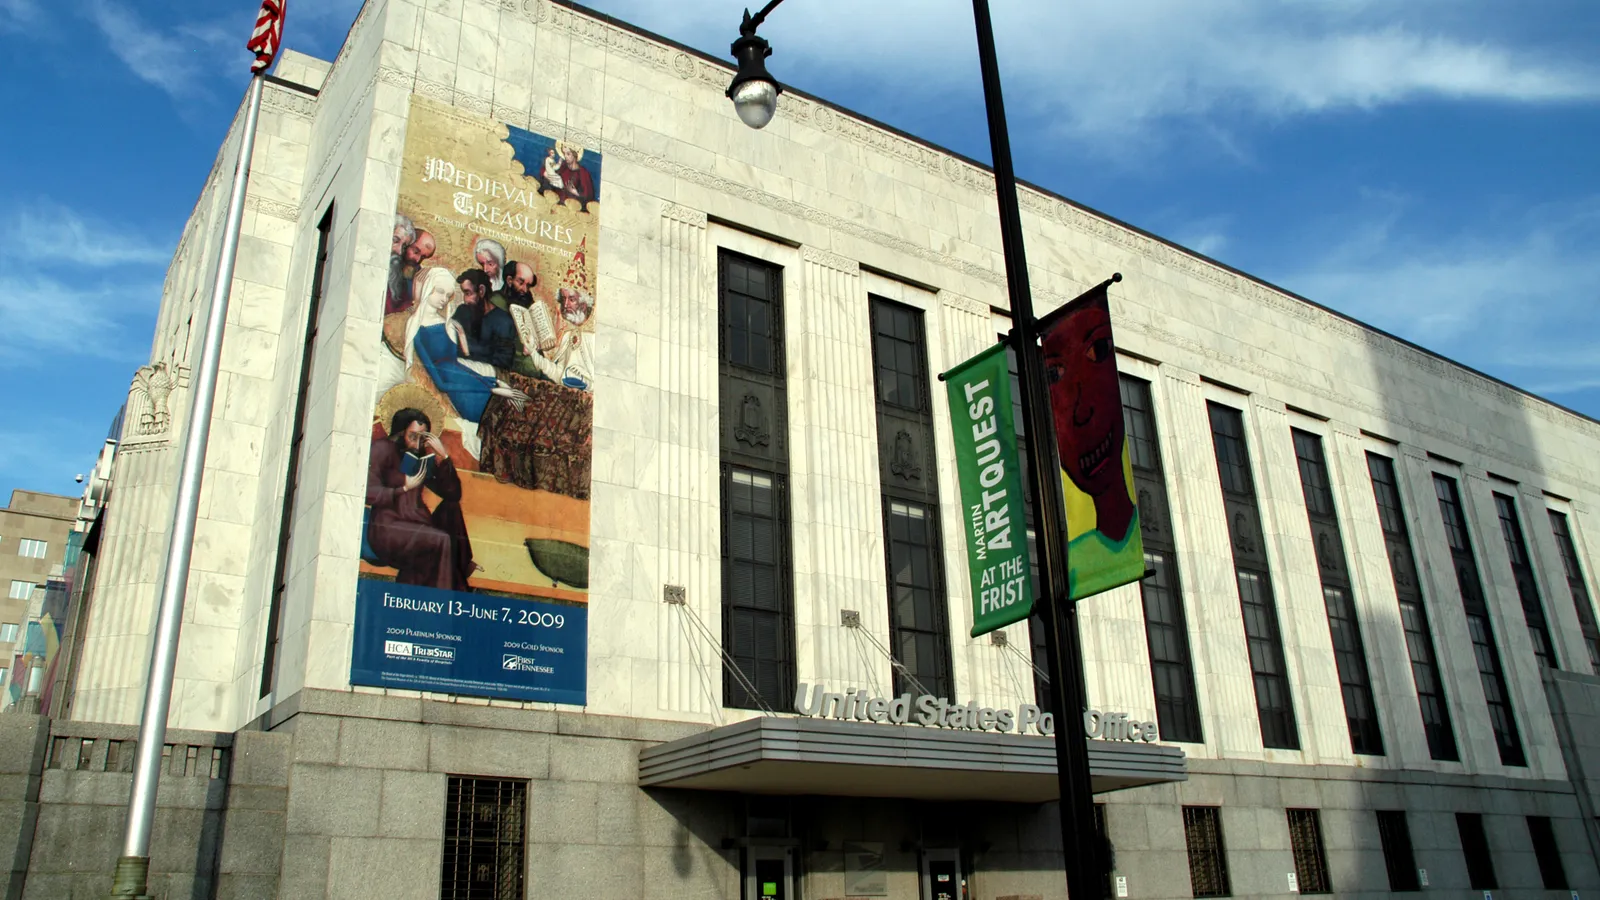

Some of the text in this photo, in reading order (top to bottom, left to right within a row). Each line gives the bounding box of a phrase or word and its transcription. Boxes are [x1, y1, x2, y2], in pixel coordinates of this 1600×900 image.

[422, 156, 537, 209] MEDIEVAL
[434, 214, 453, 227] FROM
[468, 222, 512, 243] CLEVELAND
[514, 234, 545, 253] MUSEUM
[547, 245, 558, 254] OF
[559, 248, 574, 258] ART
[453, 192, 573, 245] TREASURES
[964, 379, 1012, 551] ARTQUEST
[971, 504, 987, 561] MARTIN
[980, 554, 1024, 589] AT THE
[383, 592, 445, 614] FEBRUARY
[501, 607, 513, 624] 7,
[518, 609, 565, 629] 2009
[980, 576, 1025, 615] FRIST
[386, 627, 462, 642] 2009 PLATINUM SPONSOR
[388, 644, 410, 654] HCA
[503, 641, 564, 654] 2009 GOLD SPONSOR
[517, 655, 536, 665] FIRST
[517, 662, 555, 674] TENNESSEE
[795, 682, 1159, 742] United States Po Office
